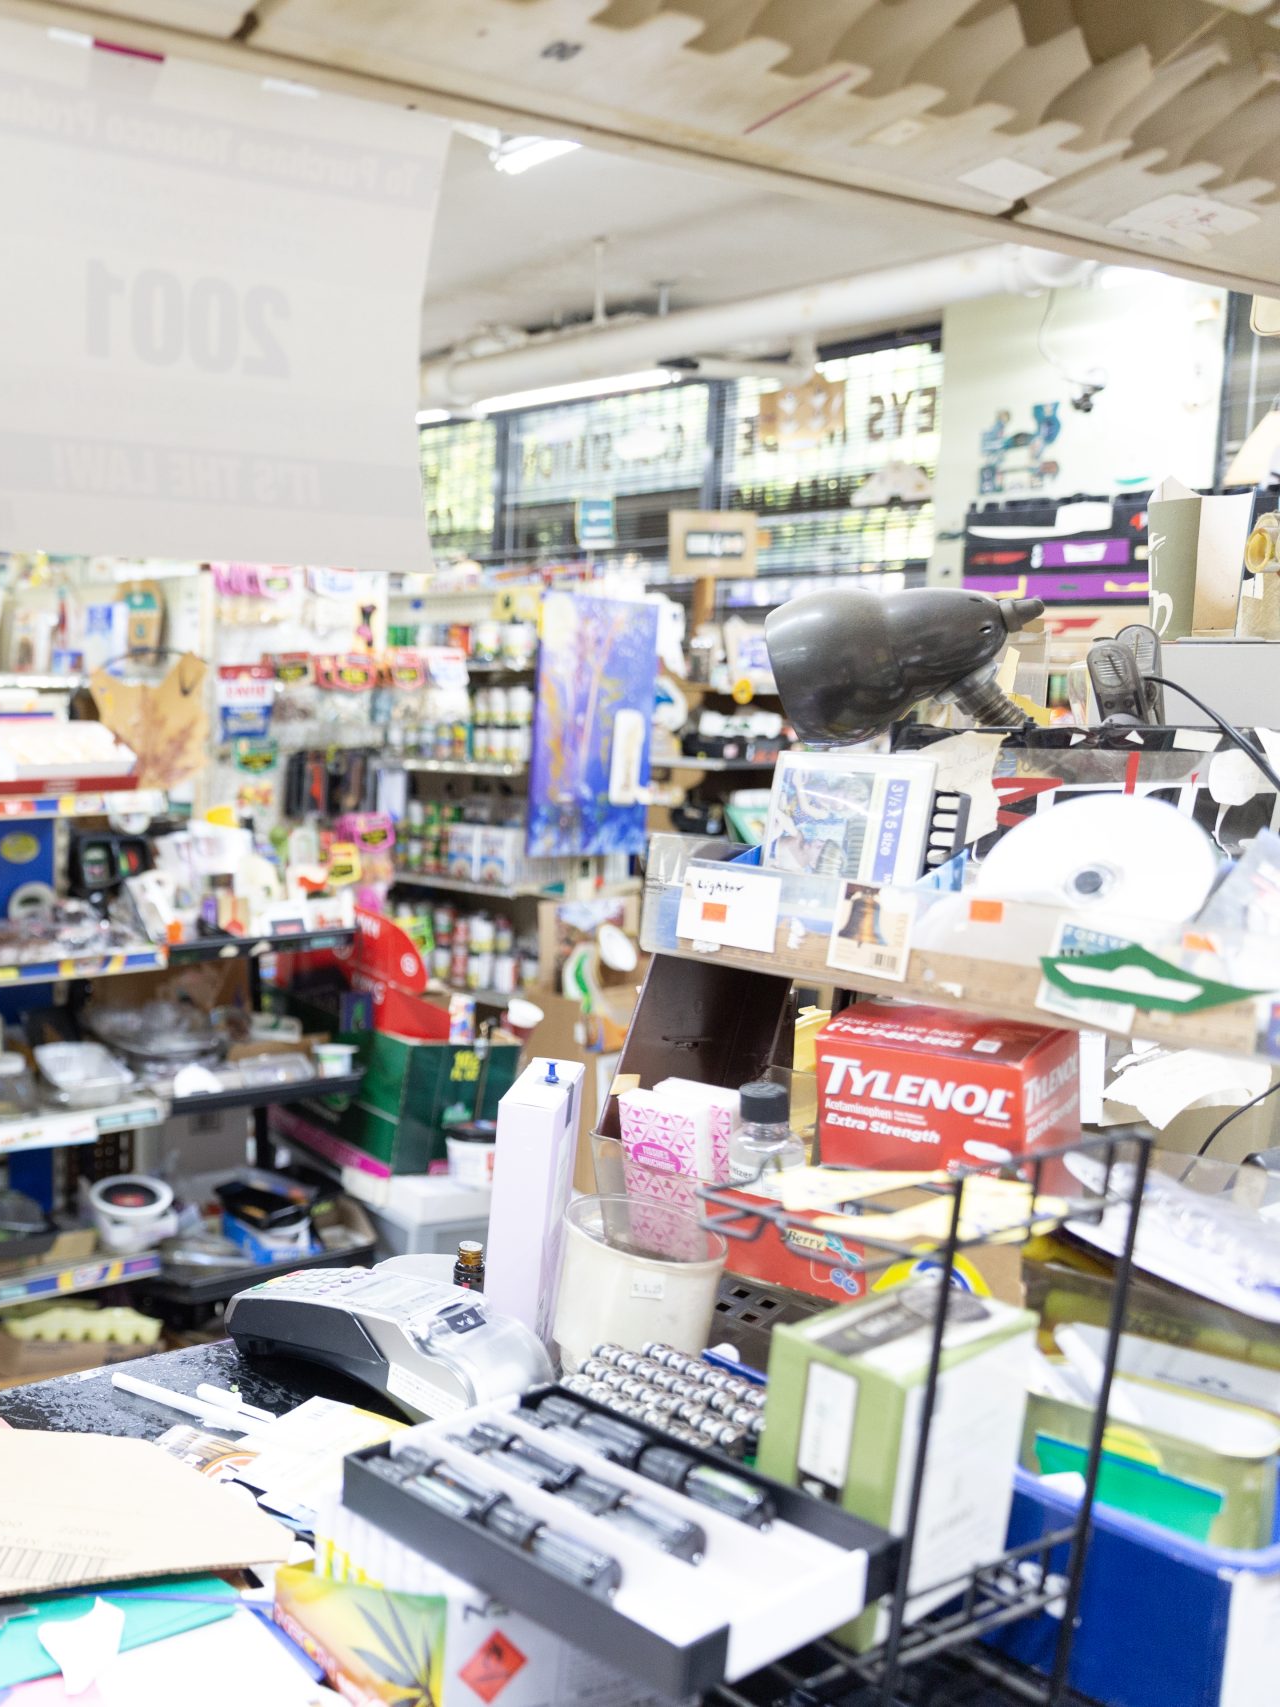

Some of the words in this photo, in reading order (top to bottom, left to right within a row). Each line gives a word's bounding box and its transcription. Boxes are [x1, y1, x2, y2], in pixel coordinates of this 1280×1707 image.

[880, 832, 895, 856] size
[821, 1055, 1013, 1121] TYLENOL
[825, 1113, 867, 1131] Extra
[869, 1121, 941, 1144] Strength
[787, 1229, 824, 1250] Berry
